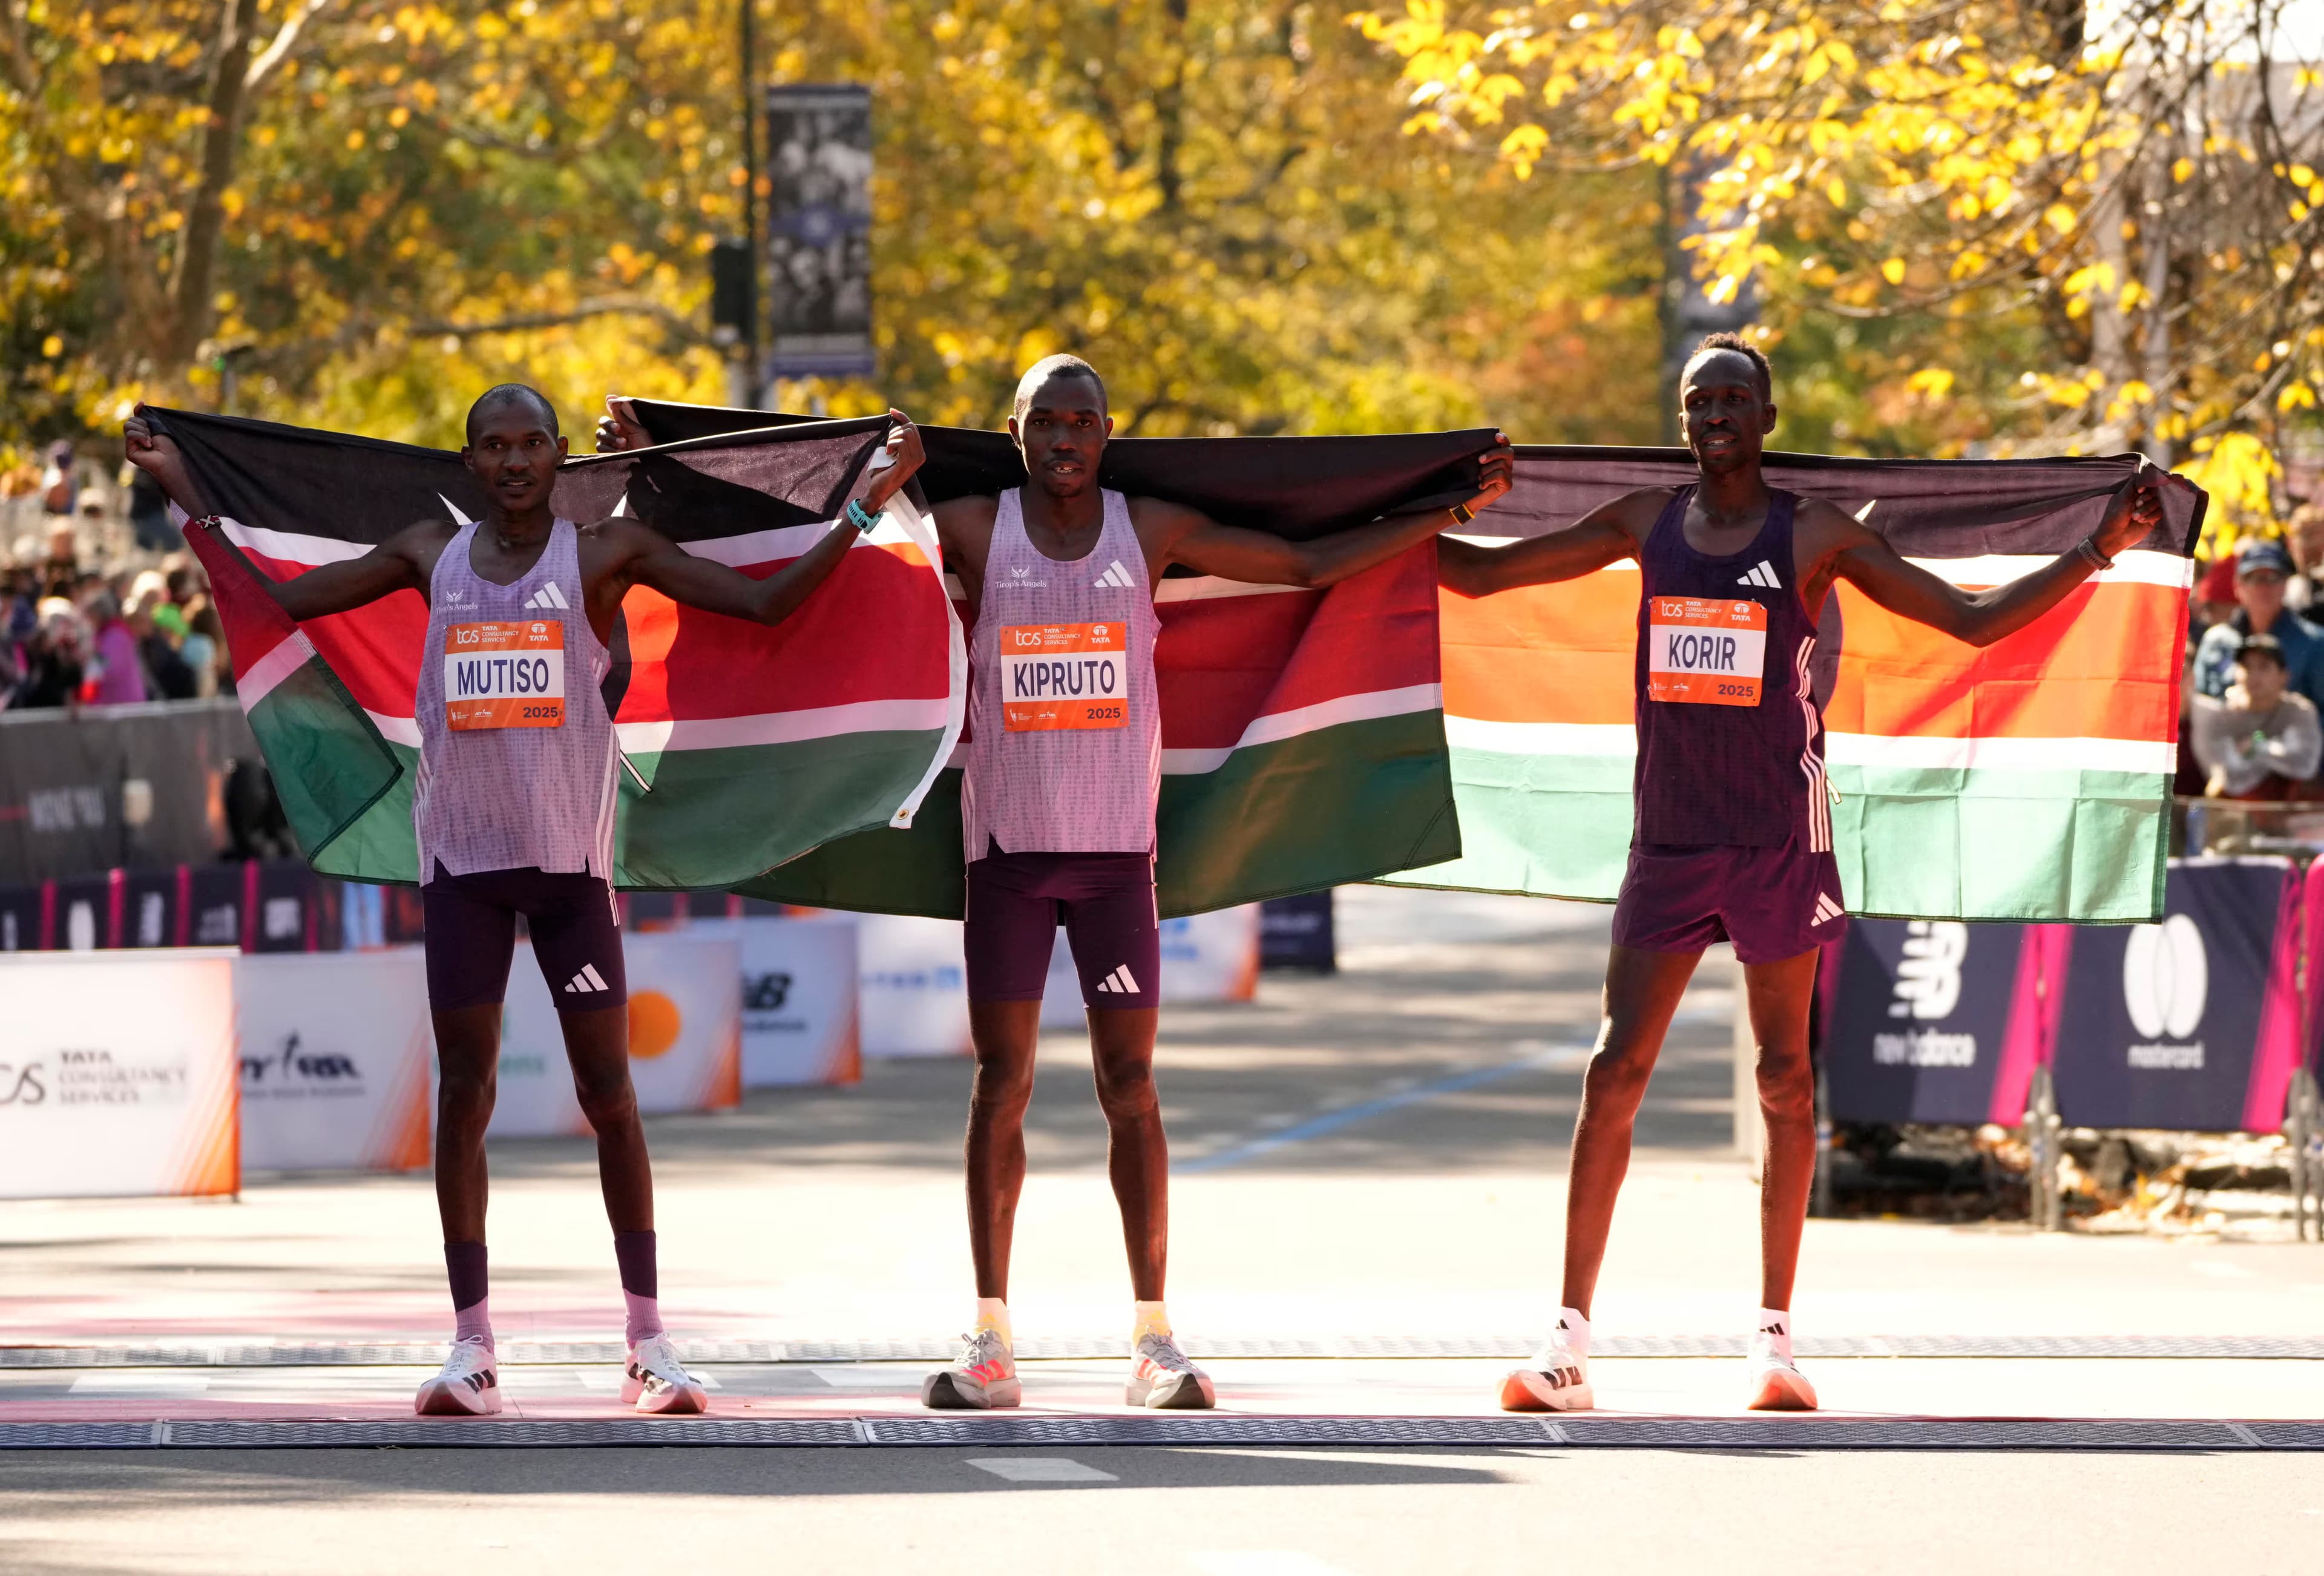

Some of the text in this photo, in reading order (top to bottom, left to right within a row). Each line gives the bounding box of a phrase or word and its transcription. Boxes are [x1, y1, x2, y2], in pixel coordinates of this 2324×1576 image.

[995, 580, 1019, 589] Tirop's
[1661, 600, 1683, 617] tcs
[456, 628, 479, 645] tcs
[1016, 629, 1041, 646] tcs
[1668, 634, 1736, 671] KORIR
[458, 658, 549, 695] MUTISO
[1014, 660, 1115, 697] KIPRUTO
[1717, 684, 1754, 697] 2025
[523, 707, 558, 718] 2025
[1087, 708, 1121, 719] 2025
